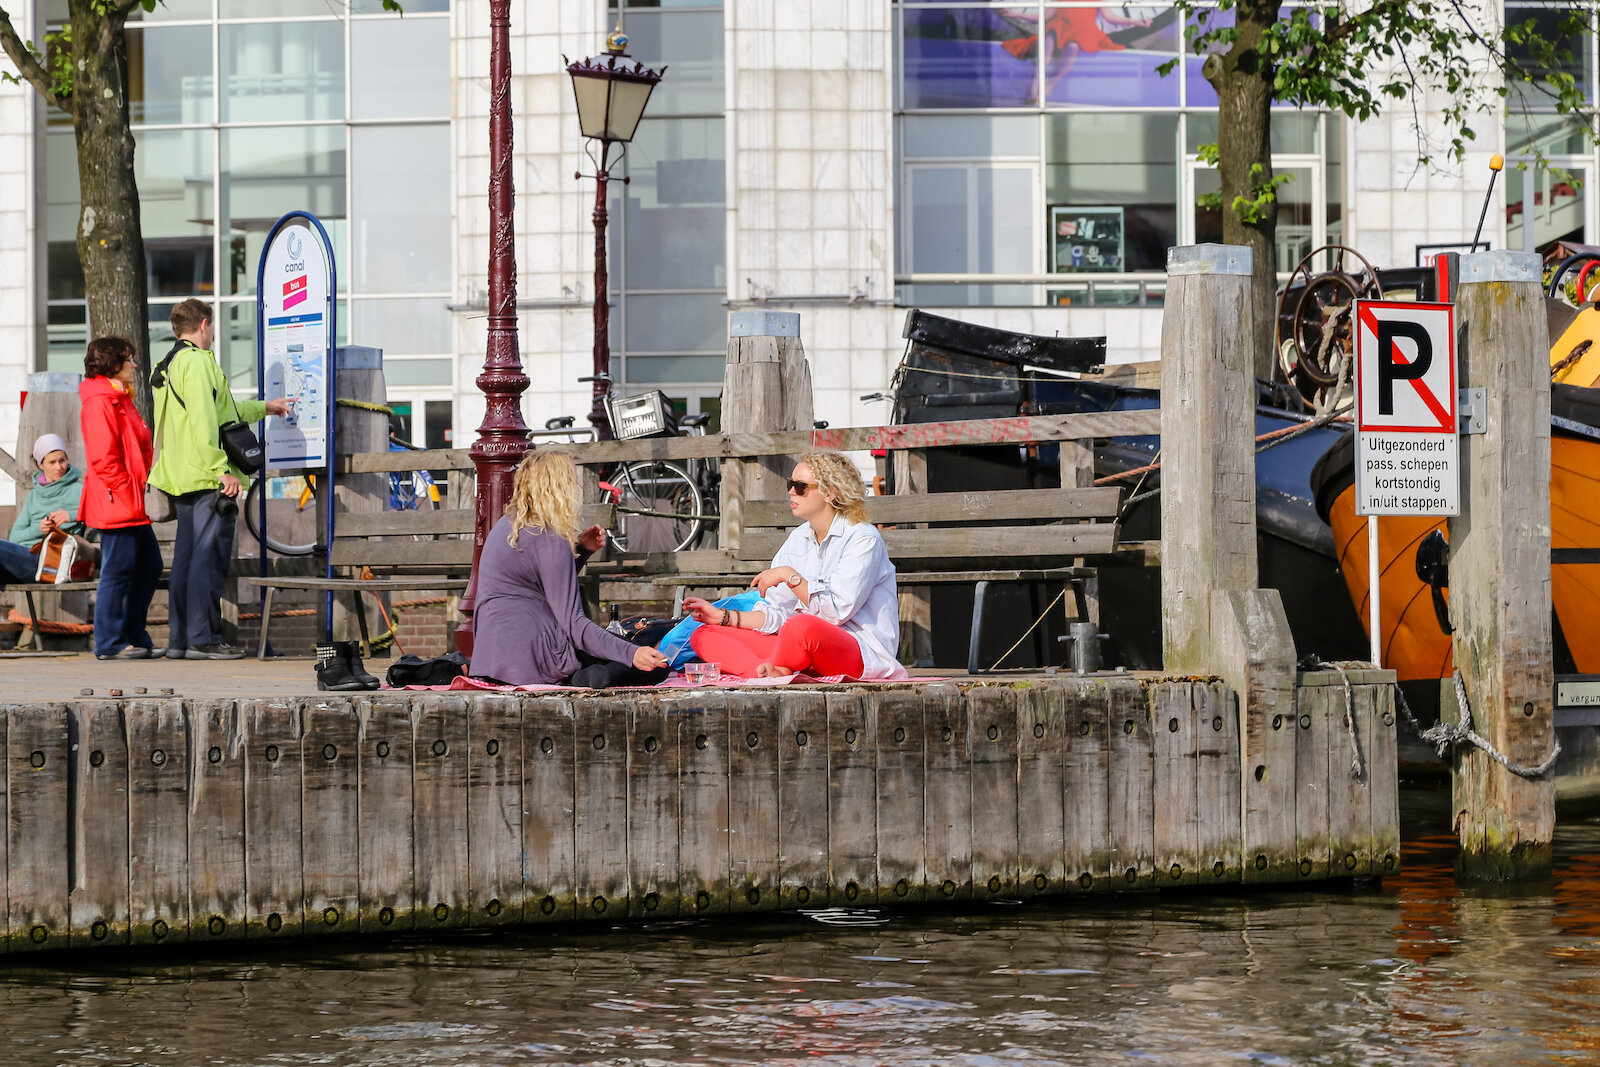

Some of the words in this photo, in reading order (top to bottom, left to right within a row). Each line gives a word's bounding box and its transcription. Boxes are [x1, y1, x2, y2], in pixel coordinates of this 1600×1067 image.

[285, 260, 305, 272] canal
[290, 281, 300, 291] bus
[1377, 319, 1433, 416] P
[1369, 437, 1445, 454] Uitgezonderd
[1366, 459, 1397, 473] pass.
[1400, 457, 1449, 474] schepen
[1375, 476, 1441, 493] kortstondig
[1369, 494, 1398, 508] in/uit
[1401, 496, 1447, 511] stappen
